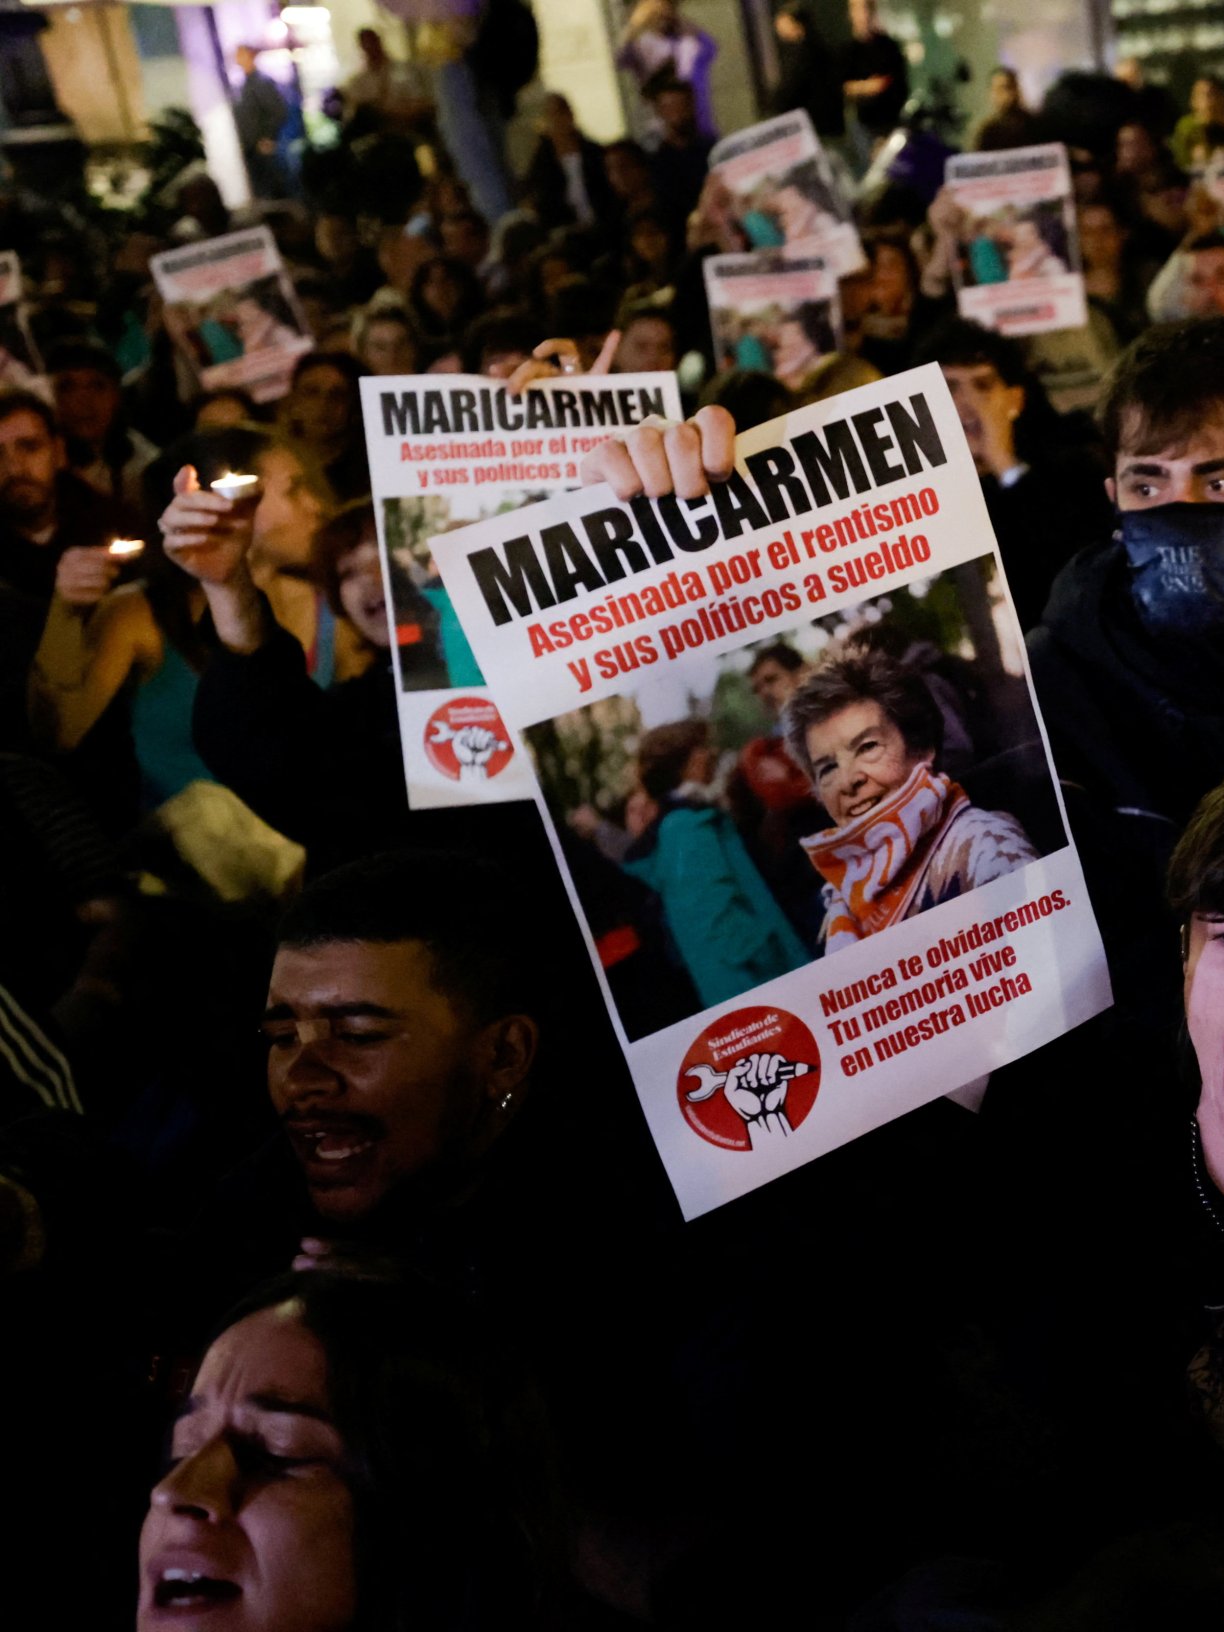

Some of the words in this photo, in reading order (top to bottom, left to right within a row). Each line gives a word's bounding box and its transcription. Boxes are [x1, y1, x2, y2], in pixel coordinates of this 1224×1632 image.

[380, 387, 666, 435] MARICARMEN
[401, 440, 507, 463] Asesinada
[511, 438, 543, 458] por
[547, 435, 568, 454] el
[417, 469, 428, 488] y
[432, 467, 469, 484] sus
[473, 461, 561, 486] políticos
[565, 462, 577, 478] a
[467, 393, 948, 626] MARICARMEN
[527, 571, 707, 658] Asesinada
[707, 548, 762, 596] por
[767, 531, 799, 572] el
[802, 488, 940, 553] rentismo
[567, 655, 590, 693] y
[594, 635, 660, 680] sus
[663, 583, 802, 660] políticos
[806, 572, 826, 603] a
[827, 534, 932, 593] sueldo
[819, 968, 897, 1017] Nunca
[899, 956, 924, 981] te
[927, 889, 1071, 969] olvidaremos.
[827, 1018, 861, 1046] Tu
[862, 968, 969, 1034] memoria
[969, 945, 1017, 983] vive
[707, 1020, 763, 1048] Sindicato
[763, 1014, 779, 1026] de
[713, 1026, 782, 1062] Estudiantes
[840, 1048, 873, 1077] en
[874, 1005, 966, 1066] nuestra
[969, 972, 1033, 1020] lucha
